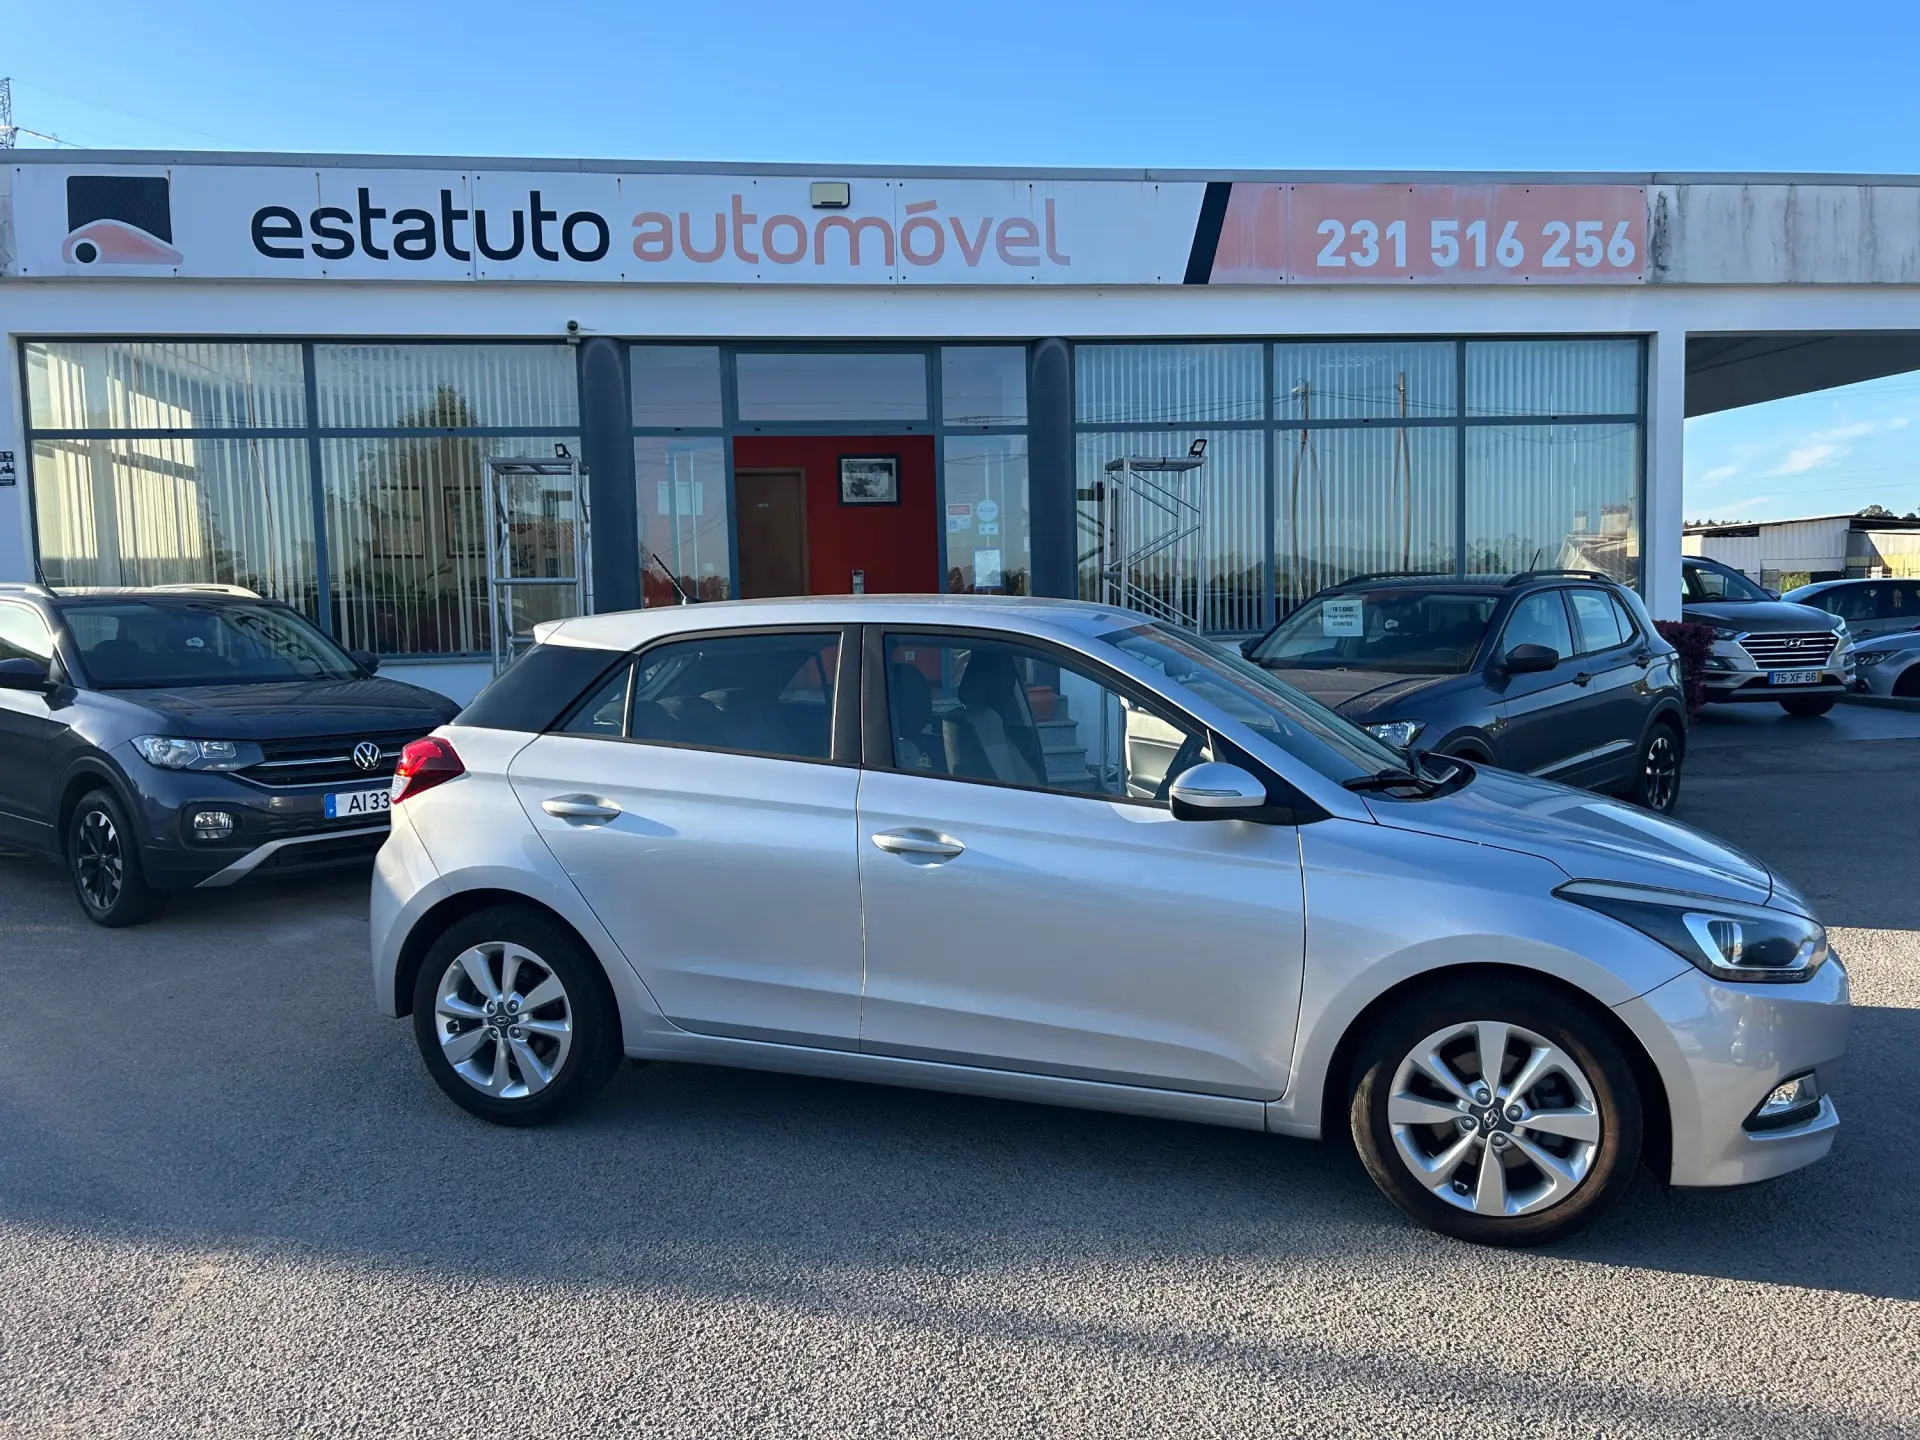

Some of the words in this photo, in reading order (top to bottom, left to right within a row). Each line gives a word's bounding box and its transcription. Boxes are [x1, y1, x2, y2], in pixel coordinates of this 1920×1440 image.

[251, 187, 610, 262] estatuto
[632, 194, 1070, 267] automóvel
[1316, 219, 1407, 267] 231
[1430, 220, 1525, 267] 516
[1541, 220, 1636, 267] 256
